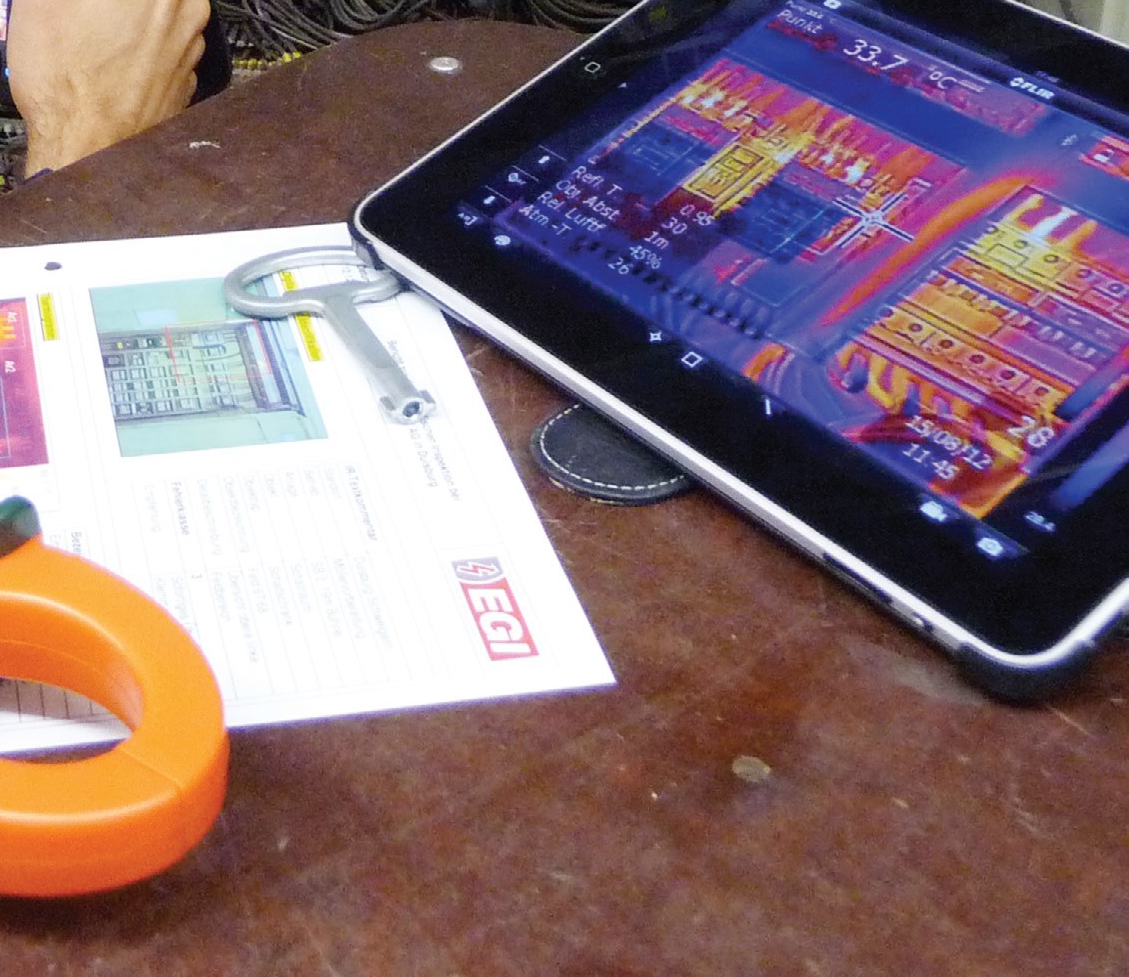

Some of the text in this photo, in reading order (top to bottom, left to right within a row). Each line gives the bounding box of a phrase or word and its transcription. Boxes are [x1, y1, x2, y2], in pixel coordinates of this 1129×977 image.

[777, 8, 822, 34] Punkt
[843, 39, 909, 71] 33.7
[1021, 81, 1055, 99] FLIR
[661, 217, 687, 235] 30
[608, 258, 630, 275] 26
[630, 245, 661, 270] 45%
[905, 415, 993, 470] 15/08/12
[1007, 414, 1055, 448] 28
[902, 443, 960, 480] 11:45
[170, 481, 190, 535] Fehlerklasse
[467, 588, 532, 653] EGI
